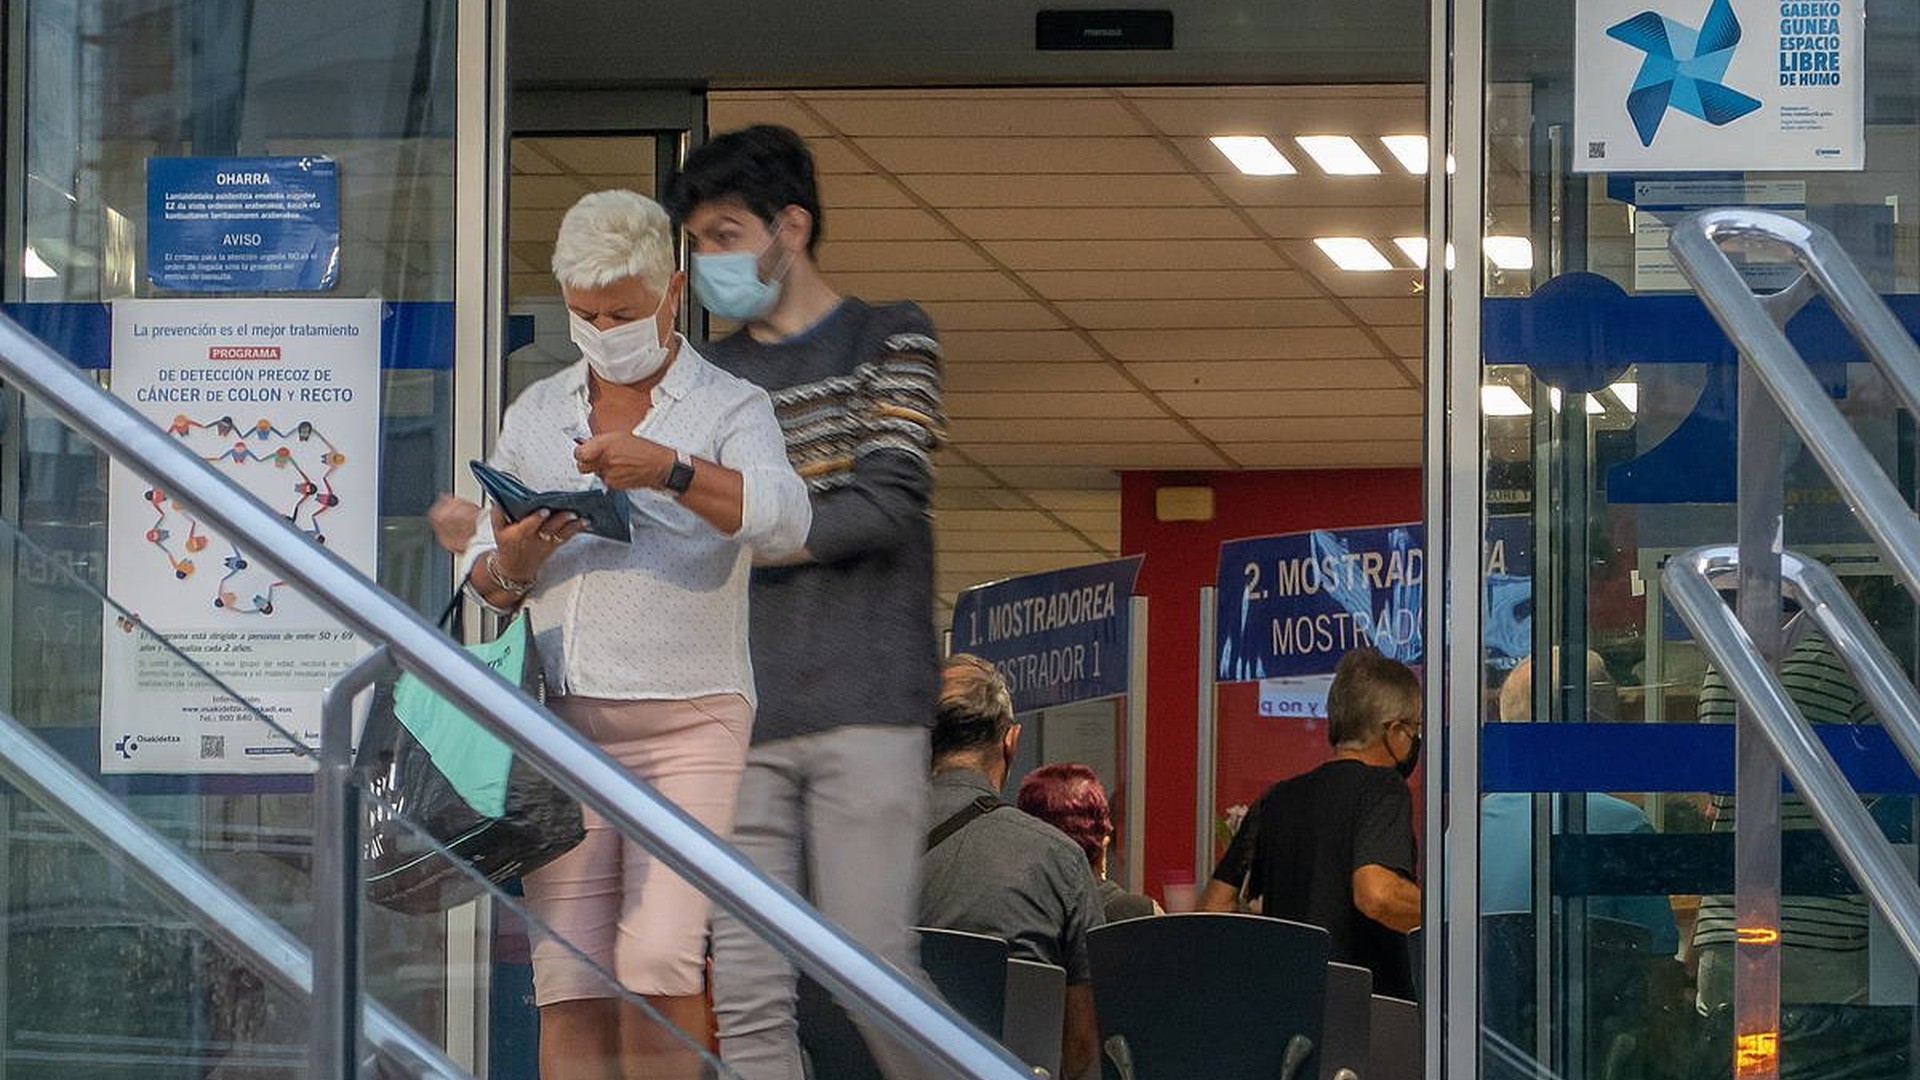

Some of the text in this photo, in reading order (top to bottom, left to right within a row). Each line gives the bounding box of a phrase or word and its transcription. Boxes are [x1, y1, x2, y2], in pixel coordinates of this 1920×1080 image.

[1780, 3, 1840, 17] GABEKO
[1780, 19, 1840, 35] GUNEA
[1780, 37, 1840, 51] ESPACIO
[1780, 52, 1840, 71] LIBRE
[1780, 73, 1840, 86] DE HUMO
[216, 173, 270, 186] OHARRA
[223, 234, 262, 246] AVISO
[133, 323, 360, 339] La prevención es el mejor tratamiento
[212, 348, 279, 359] PROGRAMA
[158, 367, 332, 382] DE DETECCIÓN PRECOZ DE
[136, 385, 201, 402] CÁNCER
[227, 388, 282, 402] COLON
[301, 388, 353, 402] RECTO
[1244, 562, 1268, 600] 2.
[969, 582, 1115, 647] 1. MOSTRADOREA
[319, 630, 331, 640] 50
[1272, 607, 1423, 656] MOSTRAD
[223, 643, 231, 652] 2
[1092, 640, 1101, 678] 1
